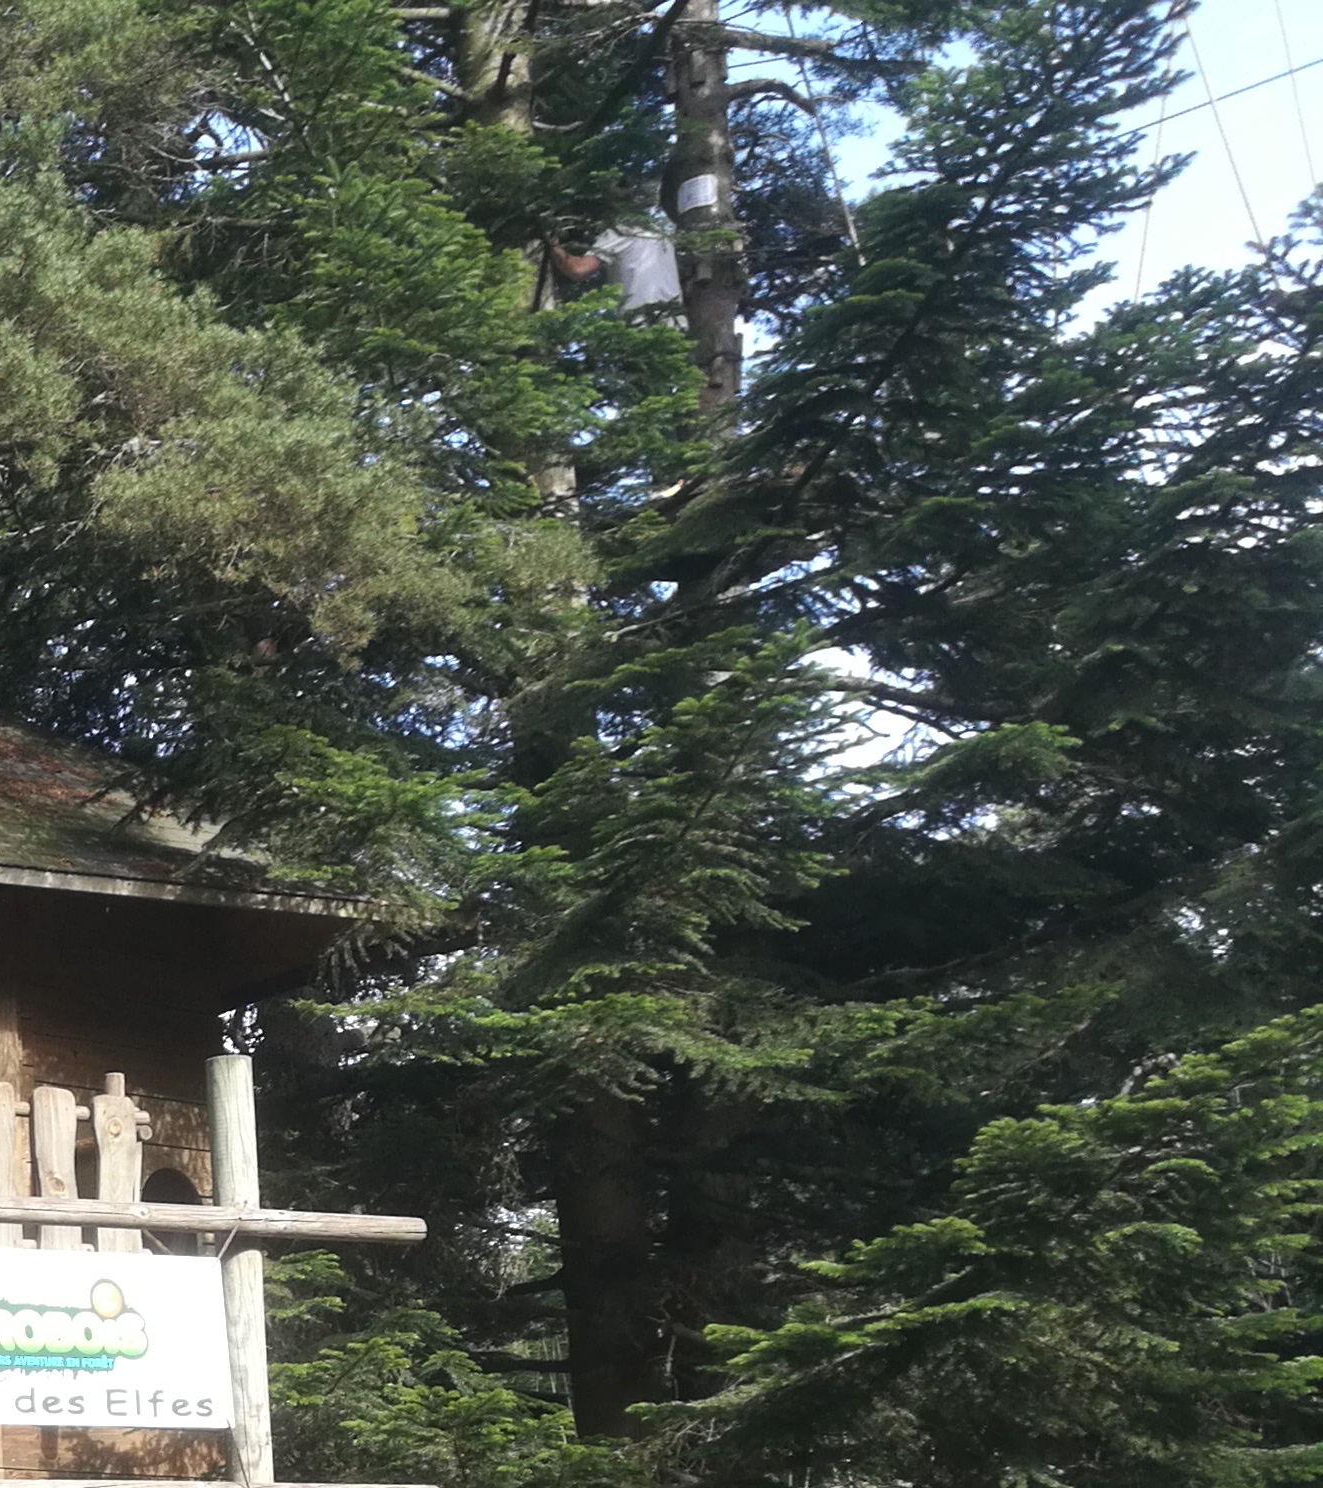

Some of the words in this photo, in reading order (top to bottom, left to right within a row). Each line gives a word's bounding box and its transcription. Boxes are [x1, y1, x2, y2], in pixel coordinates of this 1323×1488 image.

[13, 1355, 65, 1367] AVENTURE
[66, 1357, 80, 1368] EN
[14, 1386, 86, 1415] des
[105, 1388, 214, 1418] Elfes
